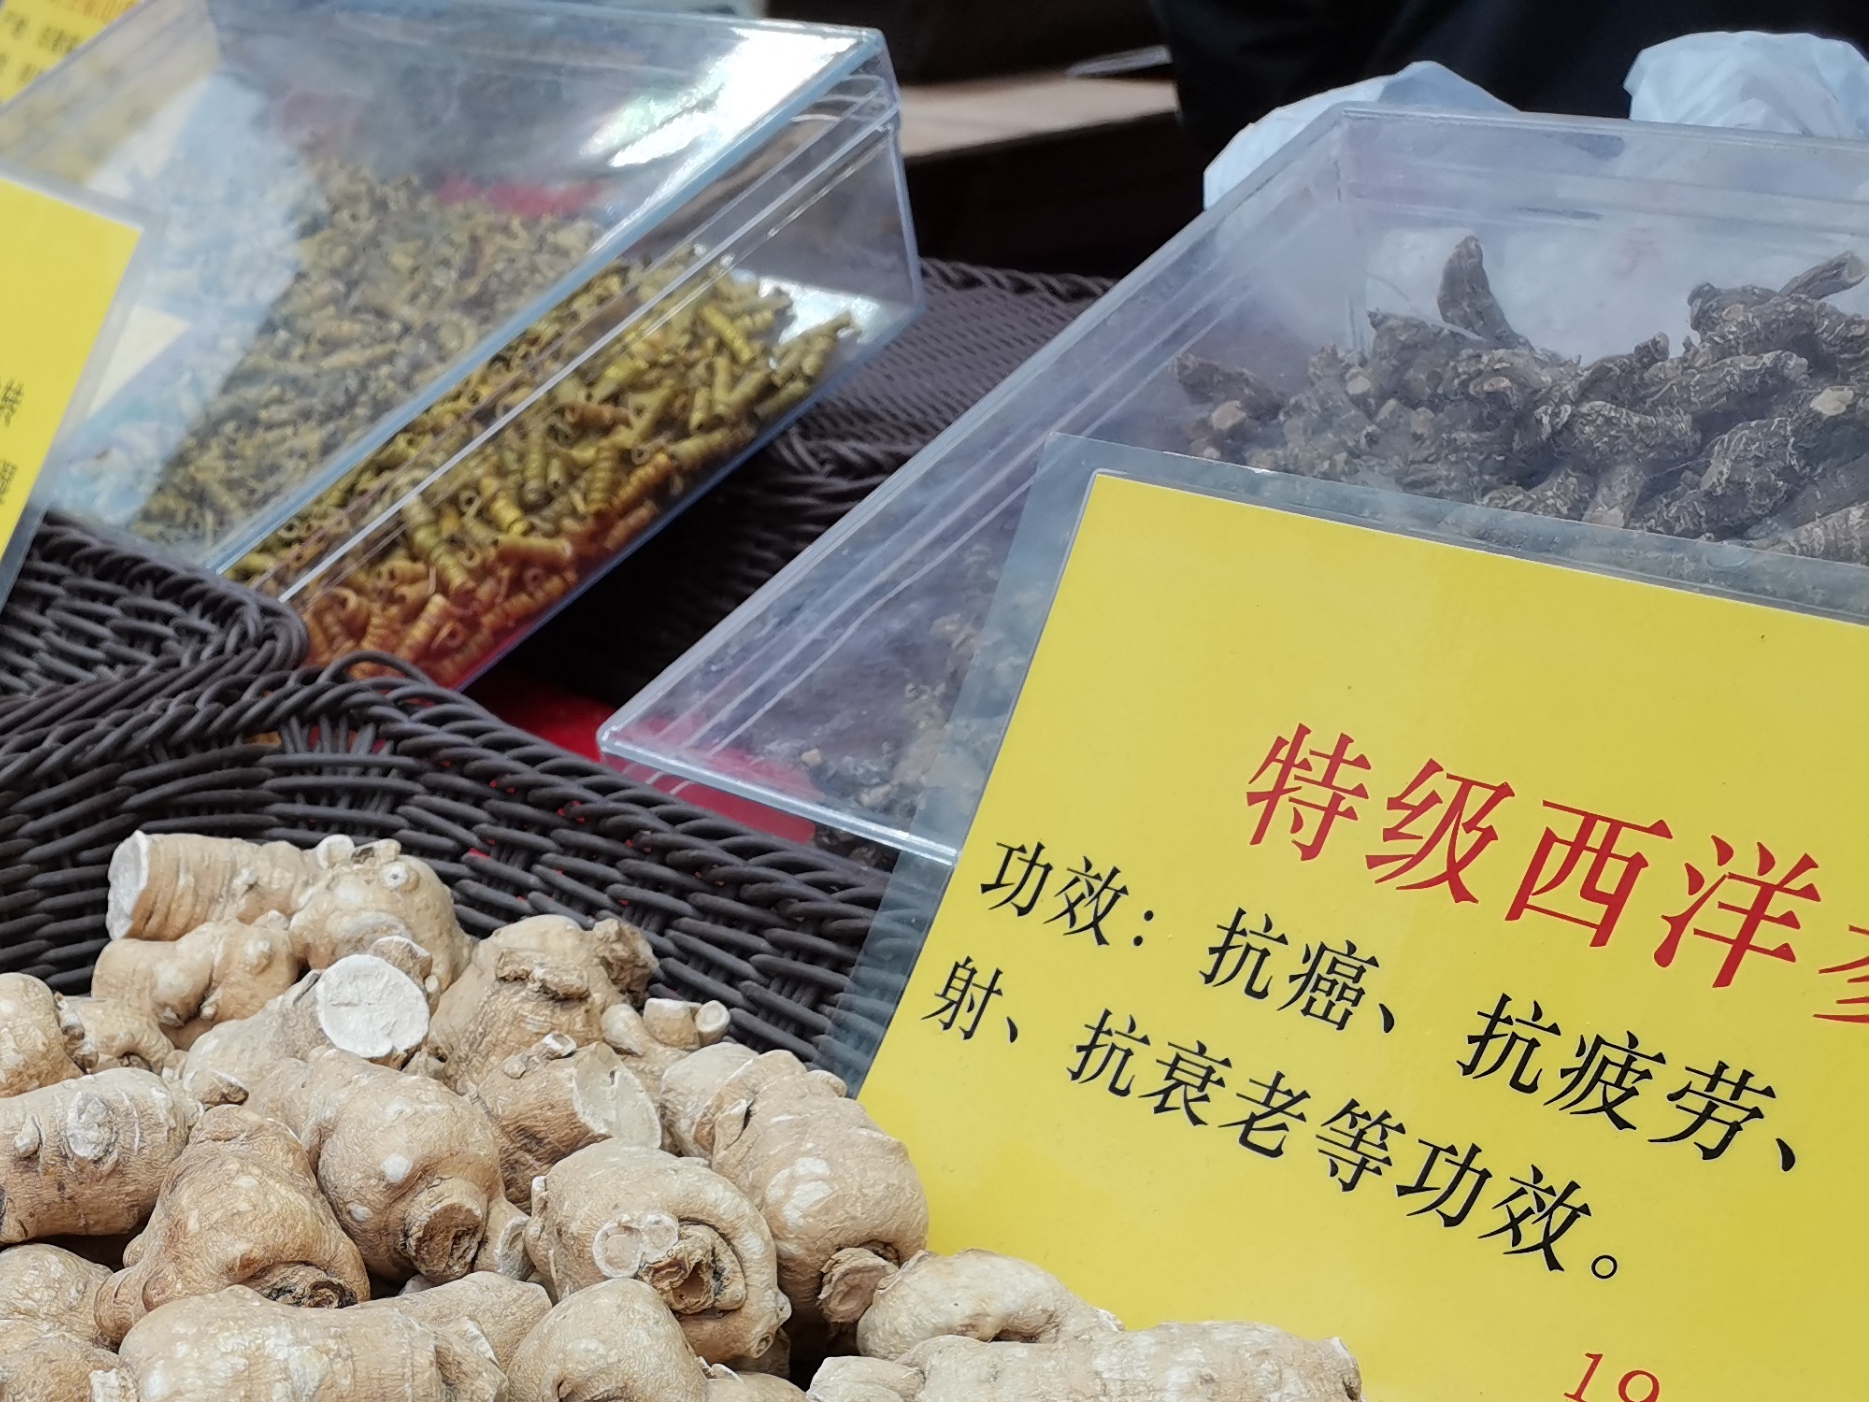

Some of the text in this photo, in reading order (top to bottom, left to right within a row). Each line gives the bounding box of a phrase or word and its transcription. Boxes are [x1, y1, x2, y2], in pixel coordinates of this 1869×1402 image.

[922, 955, 1619, 1282] 射、抗衰老等功效。
